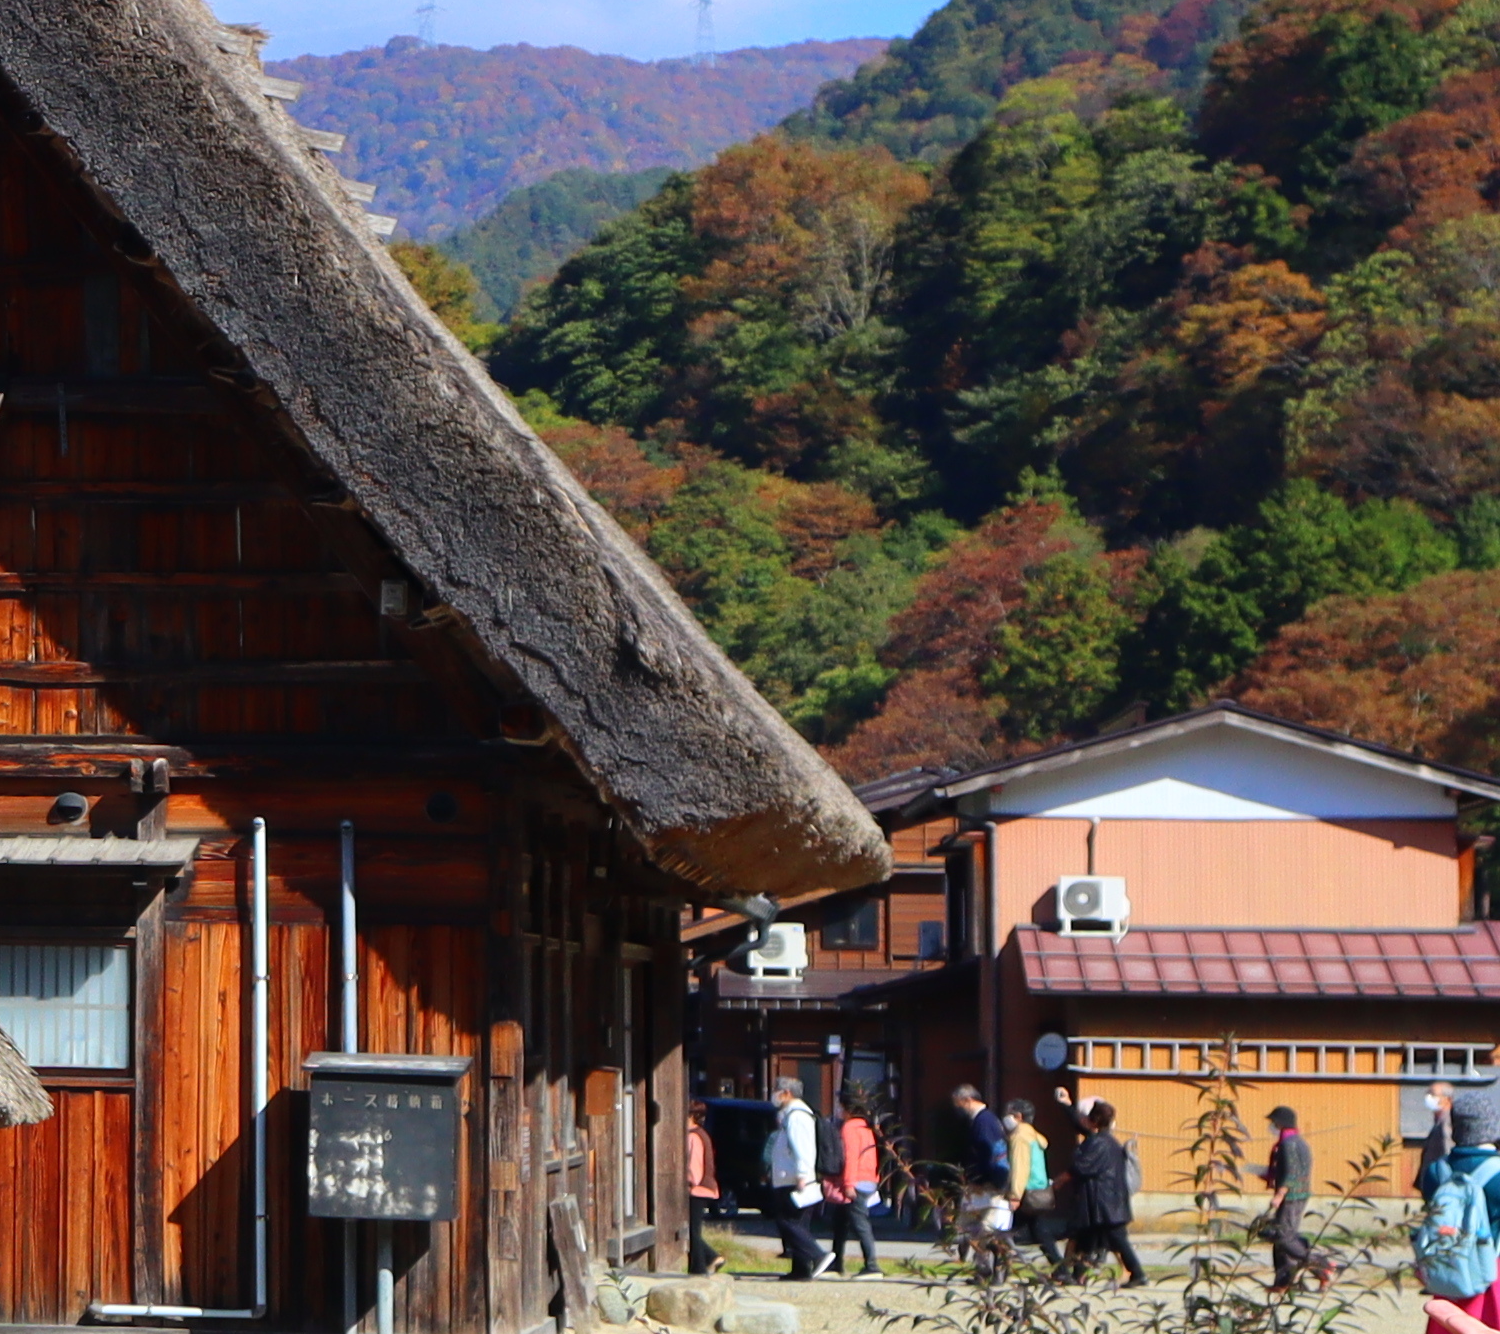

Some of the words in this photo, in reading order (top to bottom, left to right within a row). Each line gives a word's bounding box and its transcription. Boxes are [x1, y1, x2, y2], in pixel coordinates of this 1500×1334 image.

[320, 1092, 443, 1110] ホース格納箱
